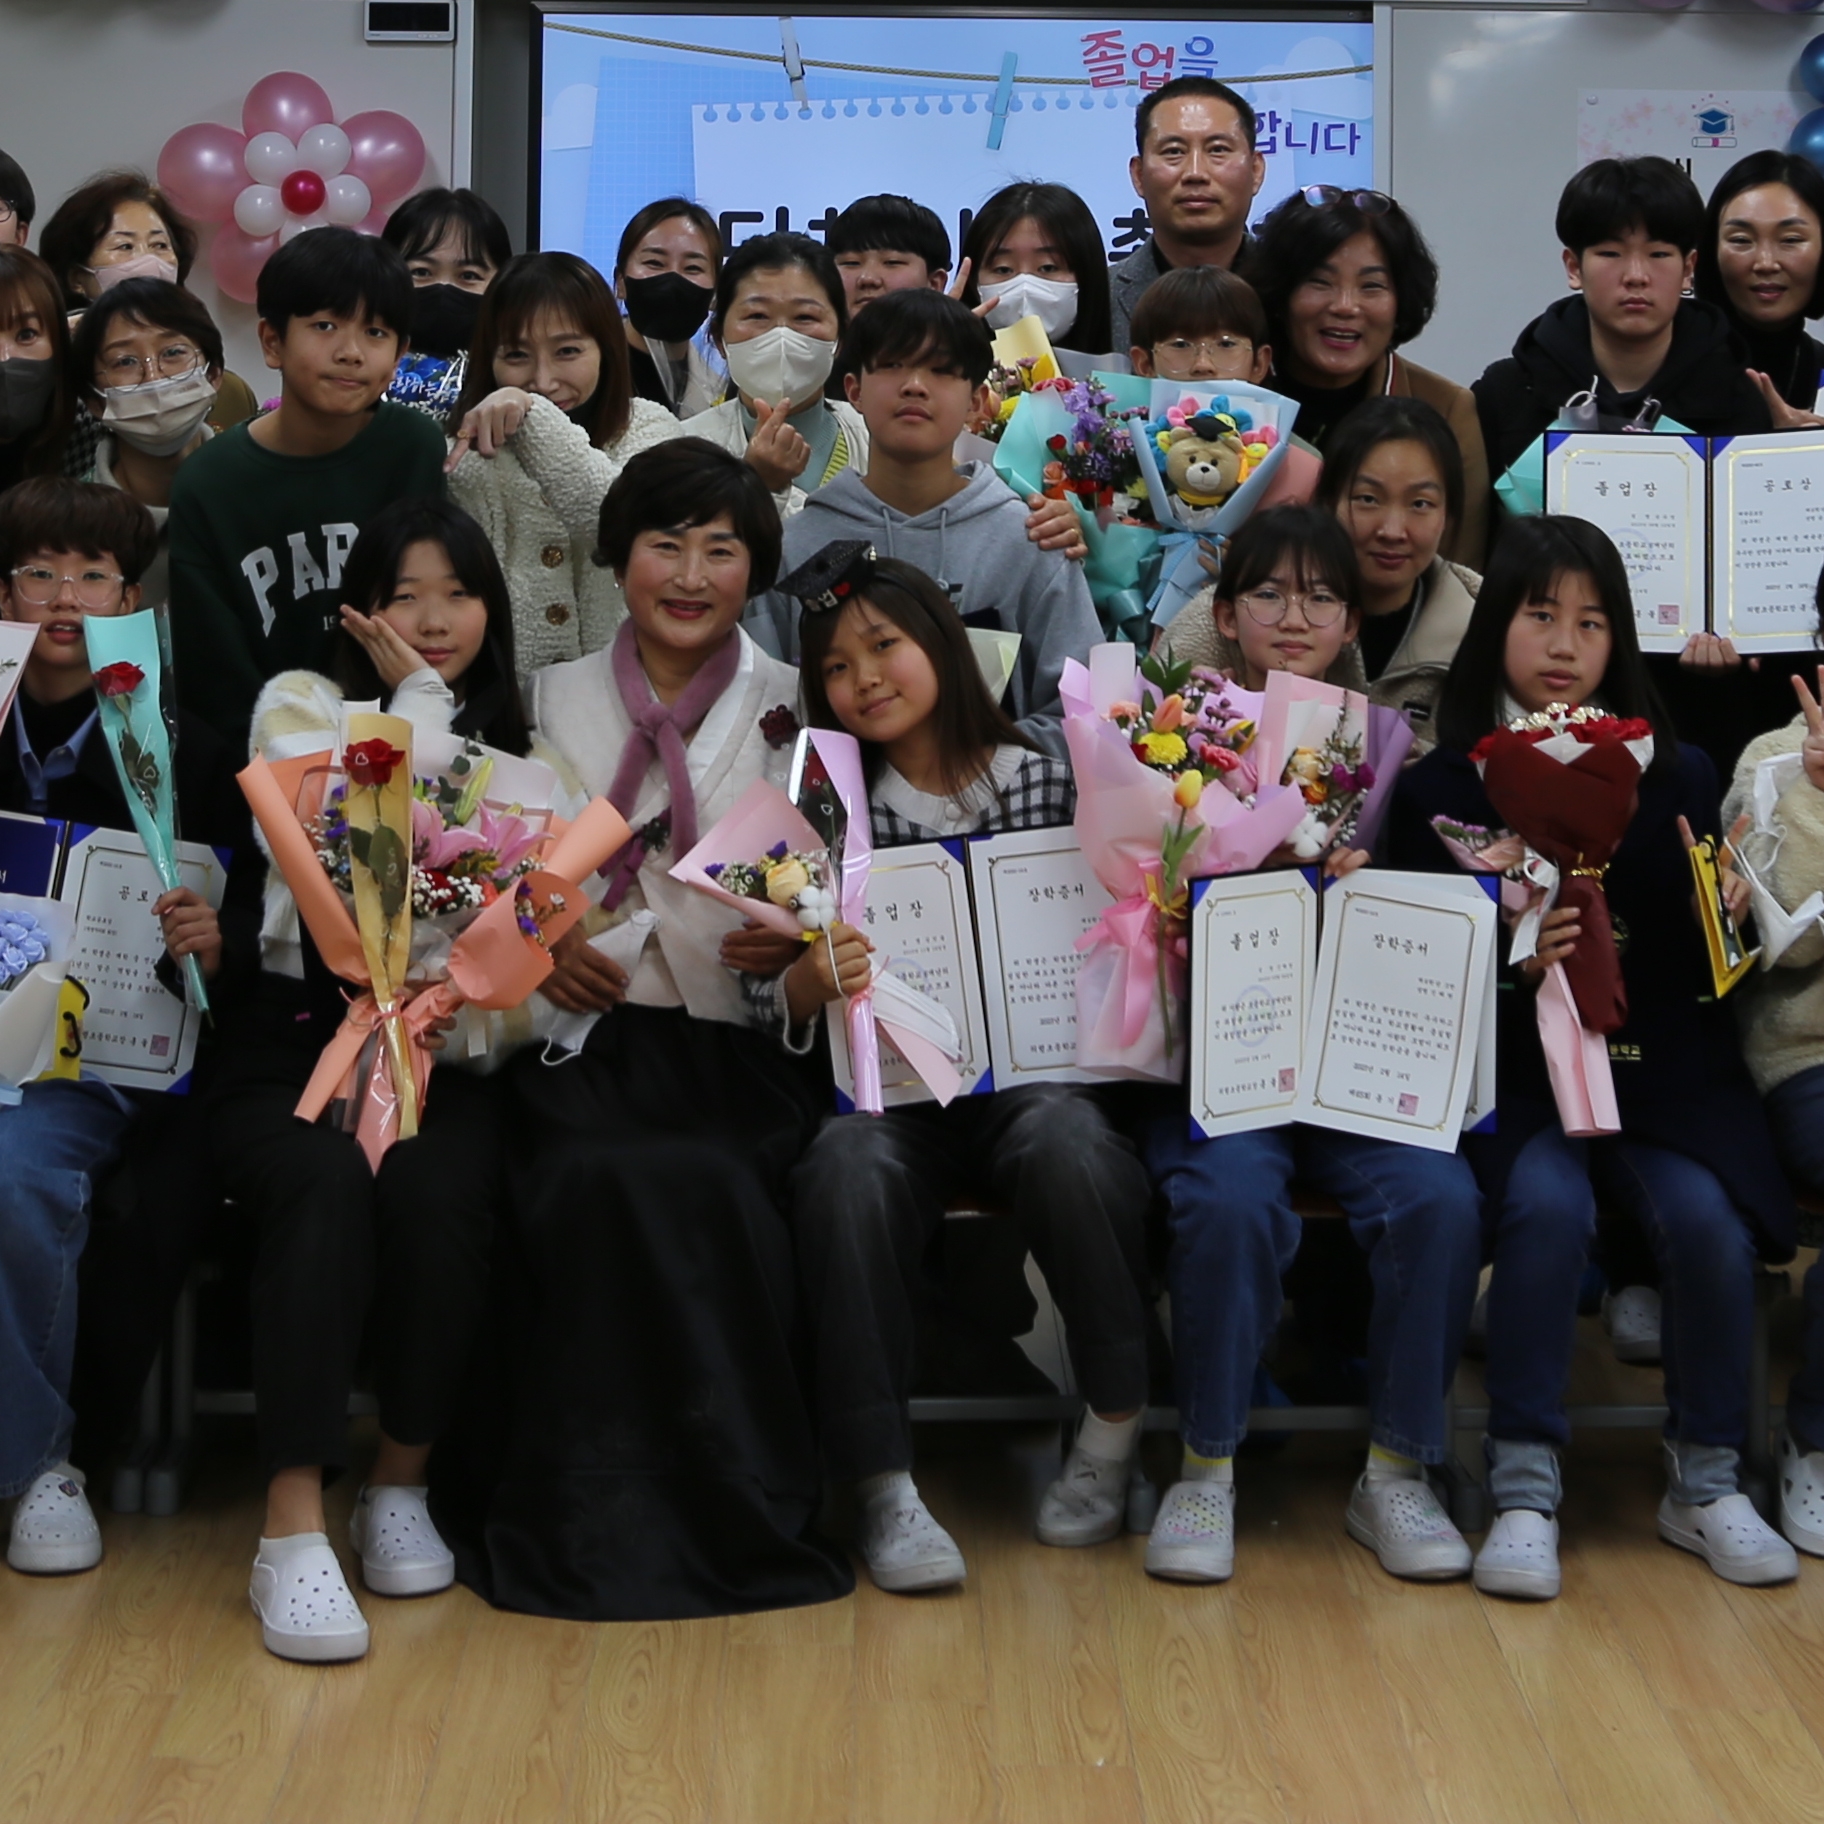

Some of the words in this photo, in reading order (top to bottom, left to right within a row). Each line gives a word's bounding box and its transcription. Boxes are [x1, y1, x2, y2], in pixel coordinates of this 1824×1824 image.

[1080, 29, 1219, 93] 졸업을
[1594, 480, 1659, 499] 졸업장
[1028, 882, 1085, 905] 장학증서
[1372, 933, 1429, 957] 장학증서
